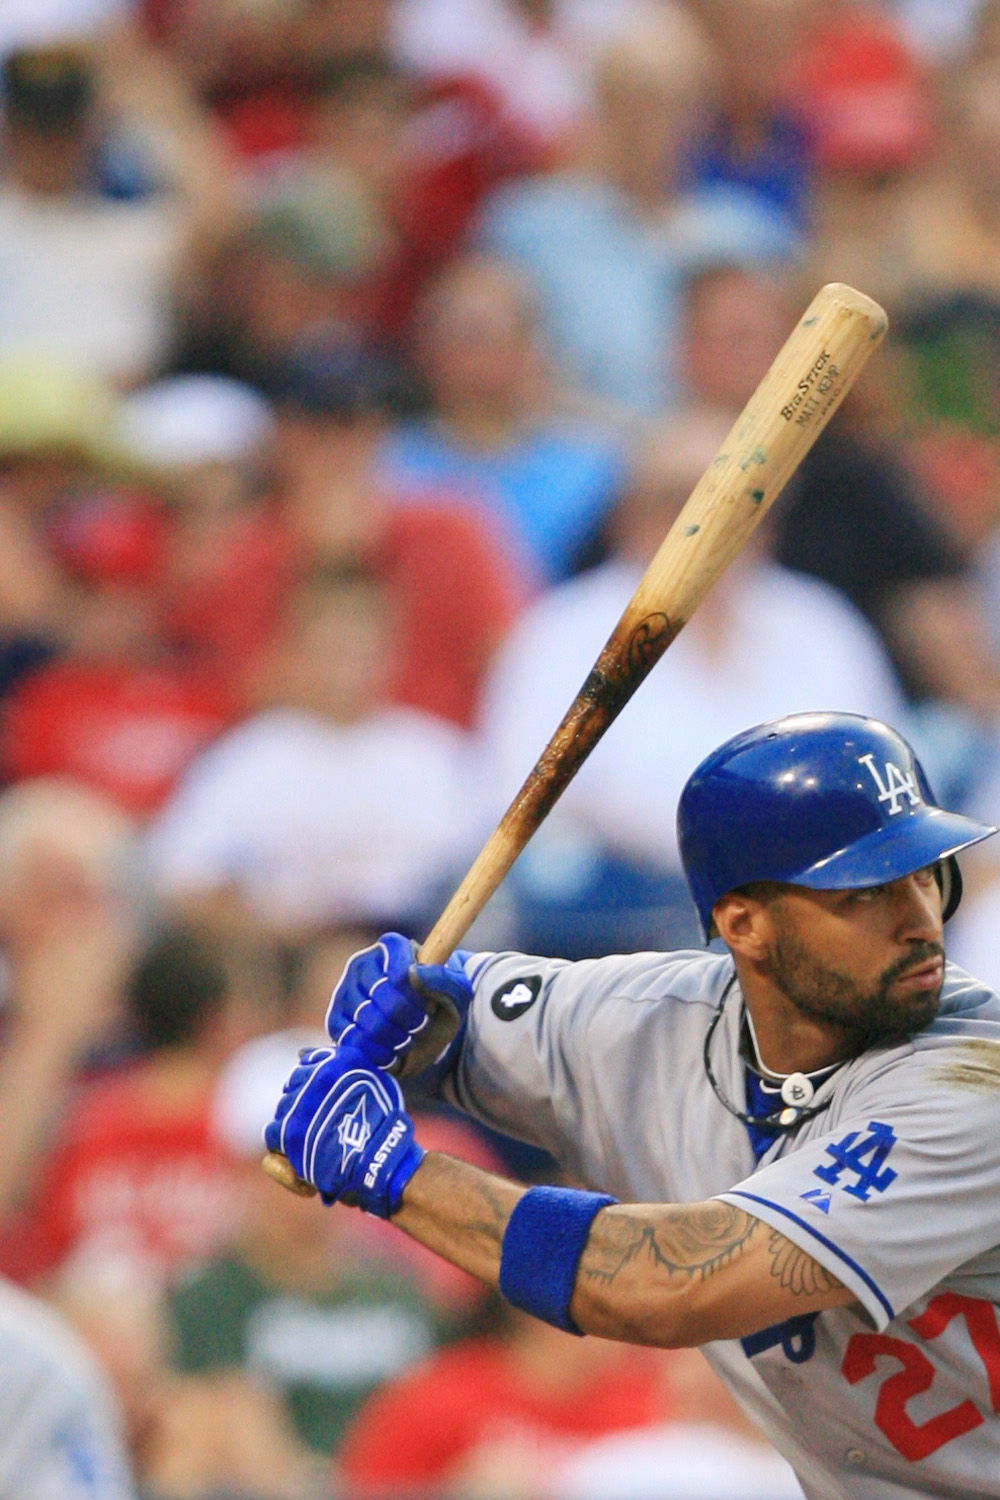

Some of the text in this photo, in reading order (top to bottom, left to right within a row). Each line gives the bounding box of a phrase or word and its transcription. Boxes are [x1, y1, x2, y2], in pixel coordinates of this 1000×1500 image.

[796, 364, 840, 427] MATT KEMP
[858, 753, 920, 815] LA
[500, 983, 533, 1008] 4
[363, 1119, 408, 1189] EASTON
[813, 1120, 898, 1202] LA
